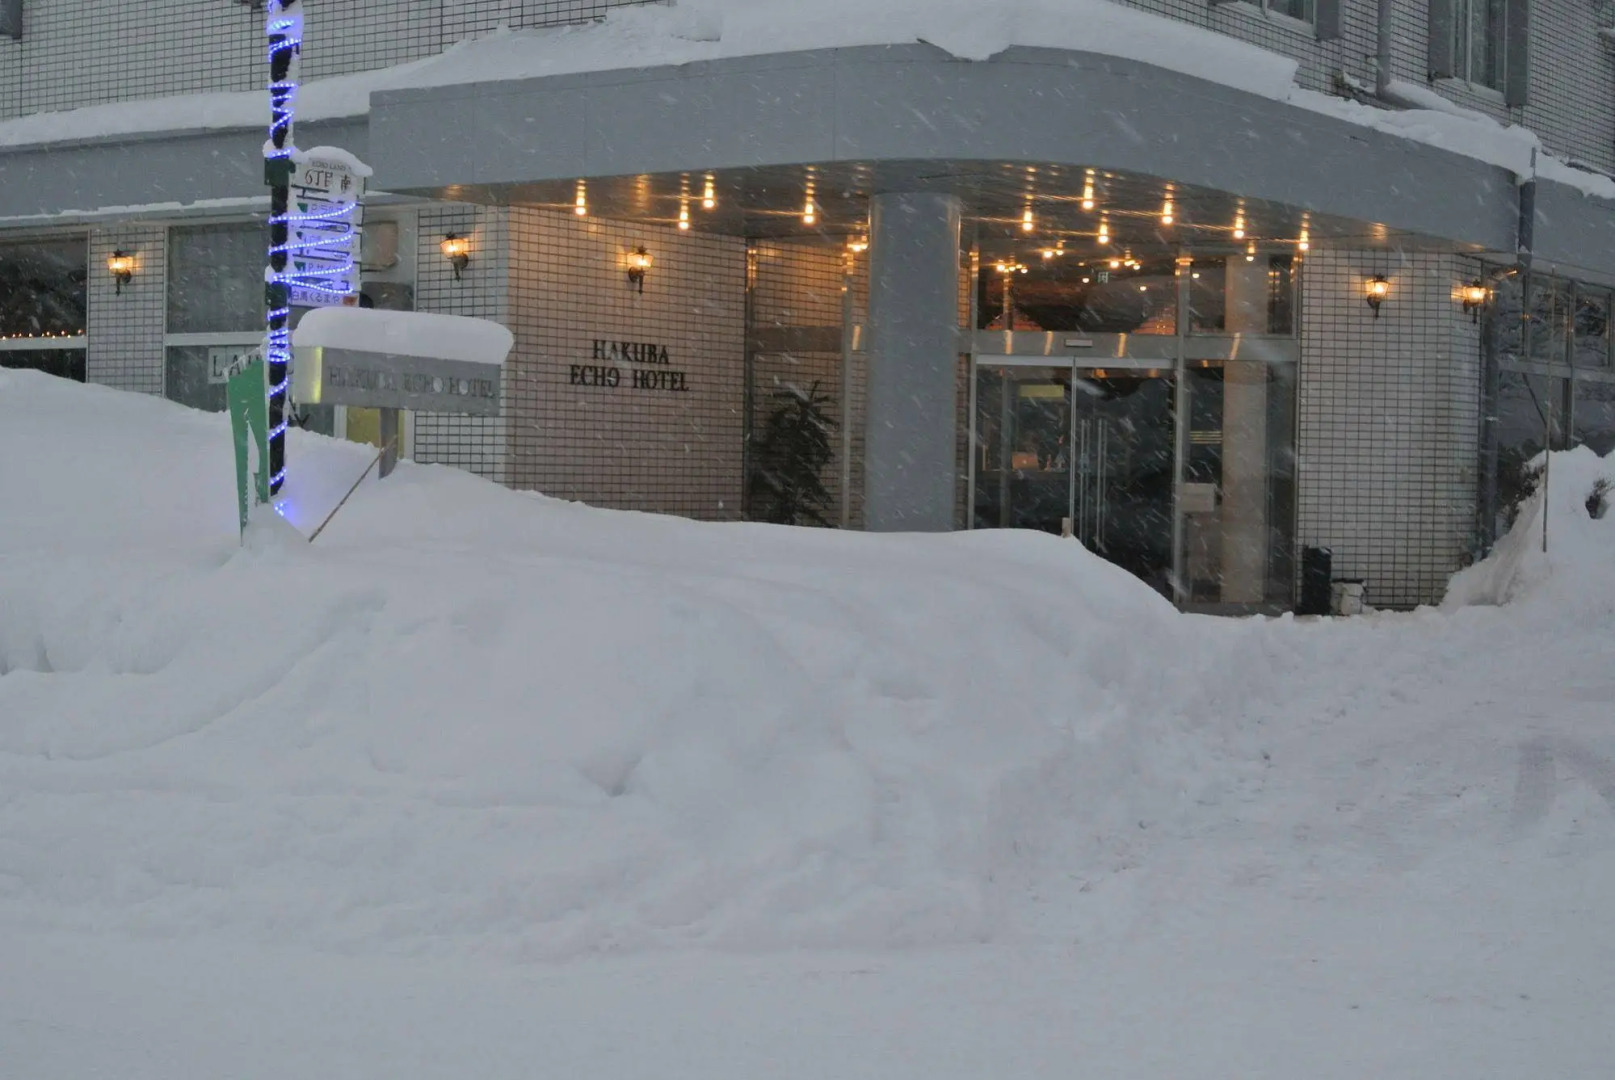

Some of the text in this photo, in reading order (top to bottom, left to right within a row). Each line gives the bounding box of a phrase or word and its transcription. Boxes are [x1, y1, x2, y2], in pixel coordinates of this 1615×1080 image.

[593, 339, 670, 365] HAKUBA
[569, 364, 689, 392] ECHO HOTEL
